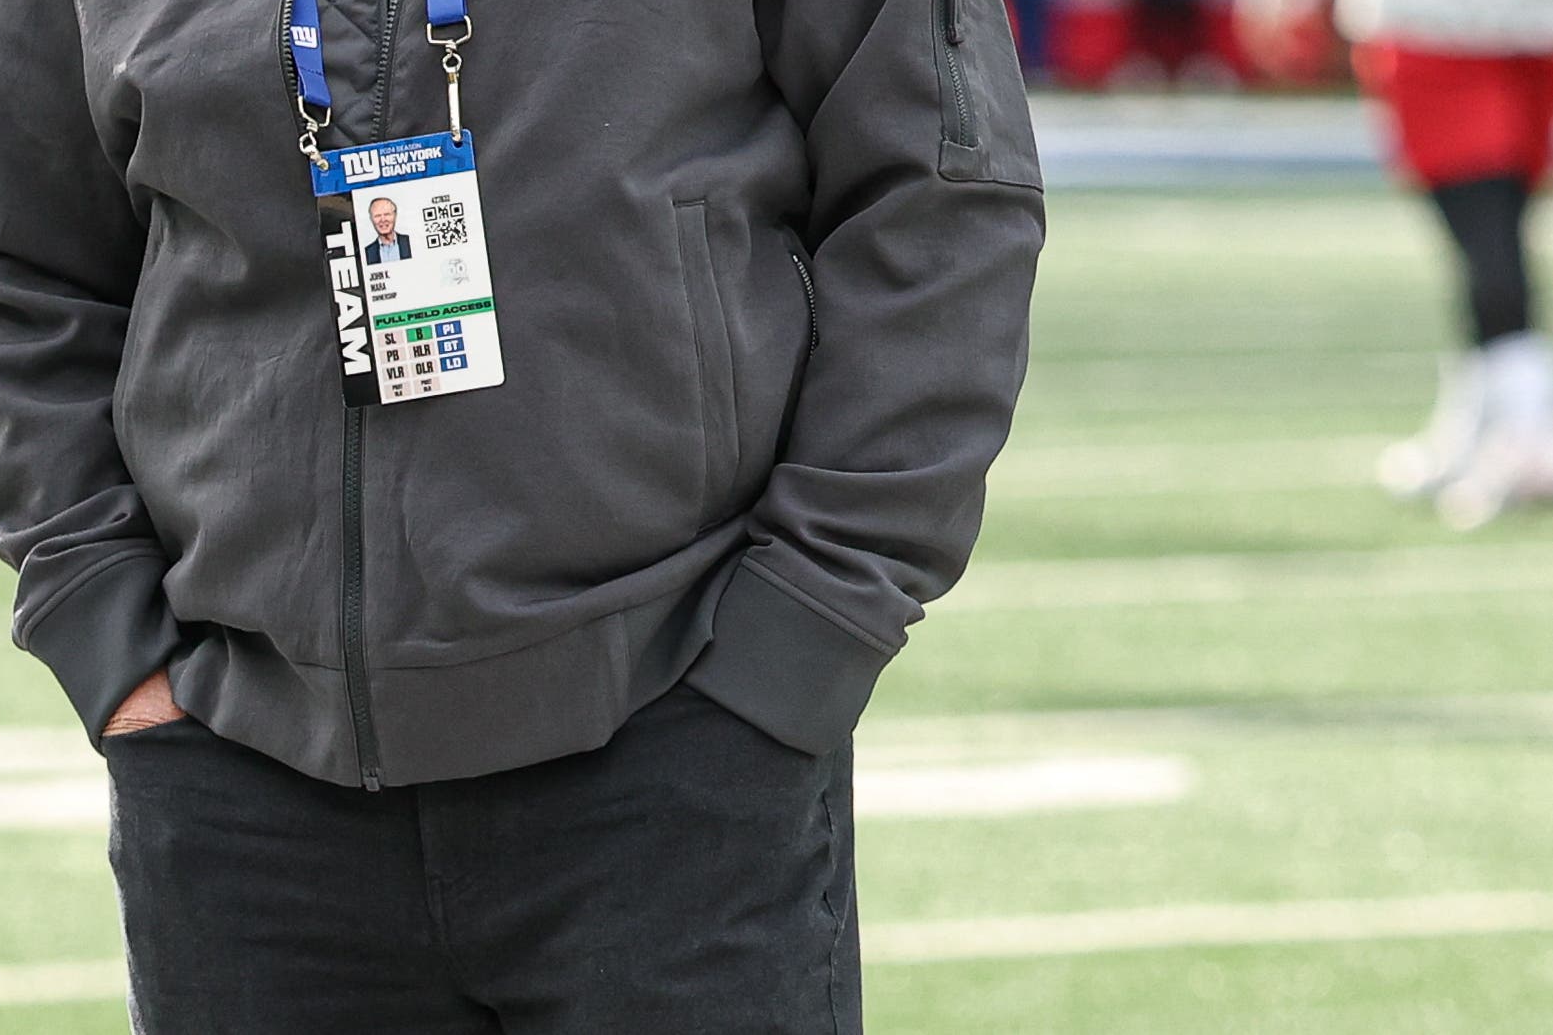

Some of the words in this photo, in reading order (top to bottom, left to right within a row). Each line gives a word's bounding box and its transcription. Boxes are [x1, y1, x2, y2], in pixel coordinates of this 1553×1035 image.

[380, 151, 406, 166] NEW
[406, 146, 442, 162] YORK
[396, 142, 422, 152] SEASON
[382, 161, 425, 177] GIANTS
[325, 221, 372, 376] TEAM
[375, 315, 406, 326] FULL
[407, 309, 440, 322] FIELD
[442, 300, 492, 314] ACCESS
[385, 332, 397, 345] SL
[416, 327, 424, 340] B
[387, 349, 400, 362] PB
[413, 344, 431, 358] HLR
[386, 366, 405, 380] VLR
